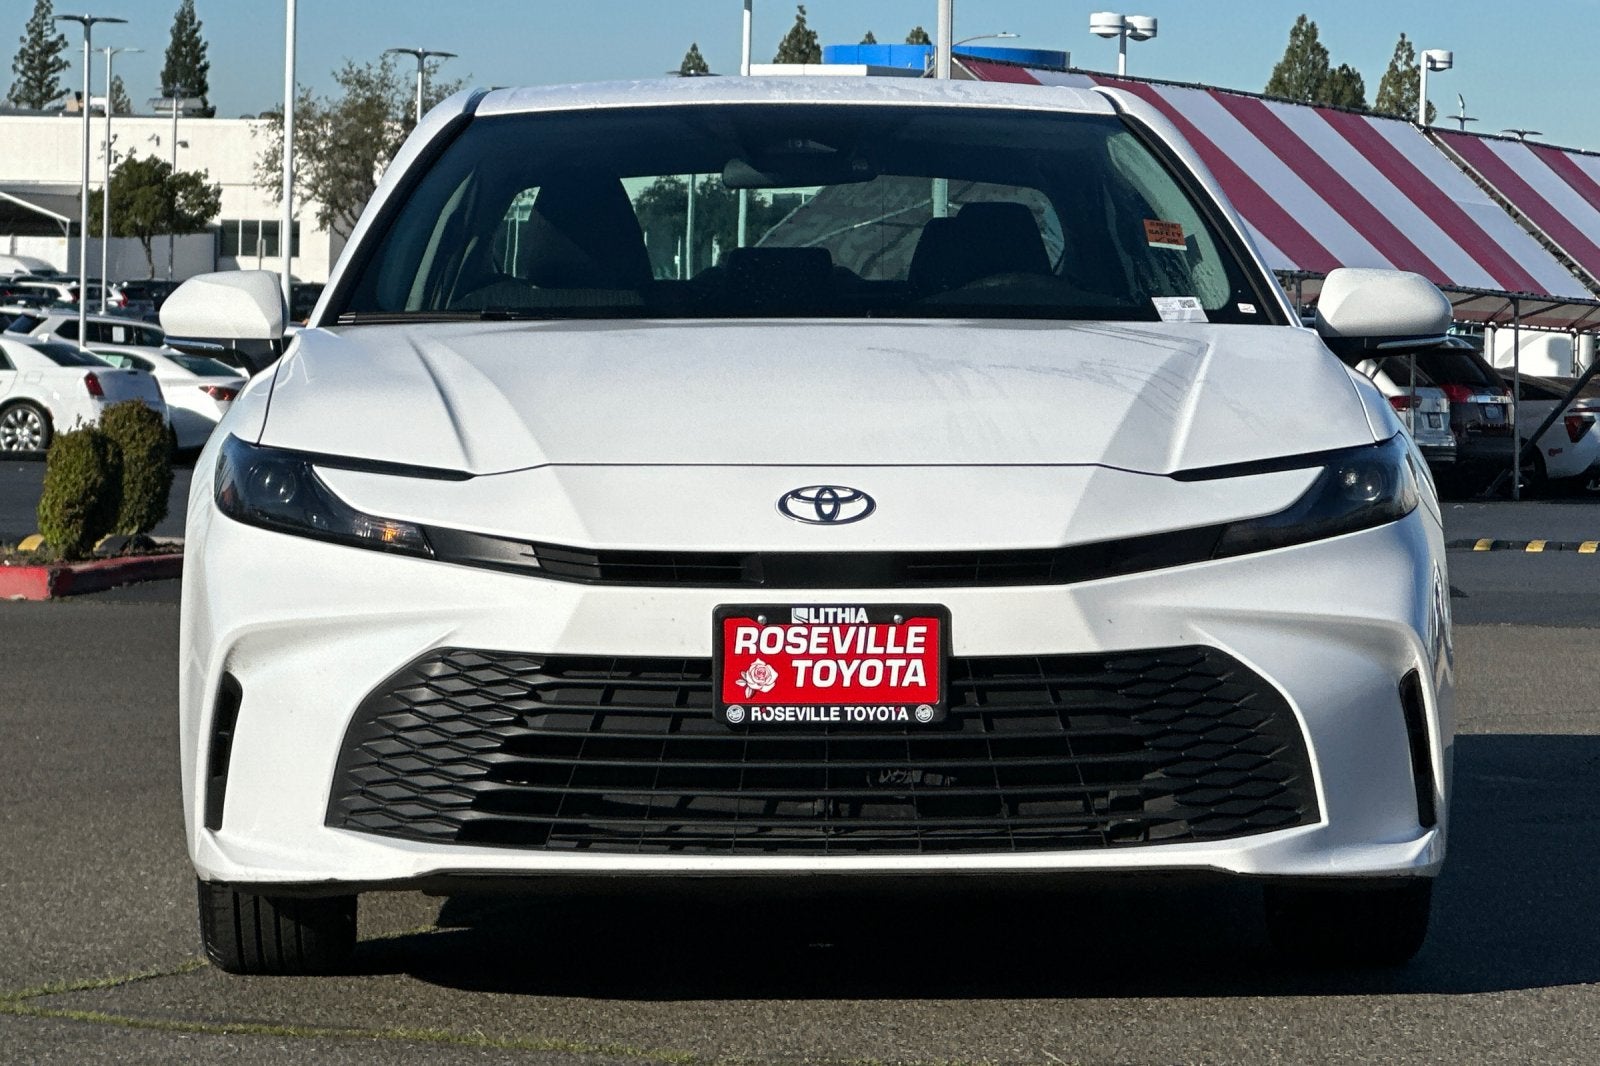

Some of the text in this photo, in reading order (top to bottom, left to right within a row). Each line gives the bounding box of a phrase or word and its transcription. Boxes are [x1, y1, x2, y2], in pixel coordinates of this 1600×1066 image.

[809, 608, 869, 623] LITHIA
[734, 626, 927, 655] ROSEVILLE
[791, 659, 927, 687] TOYOTA
[751, 706, 909, 721] ROSEVILLE TOYOTA
